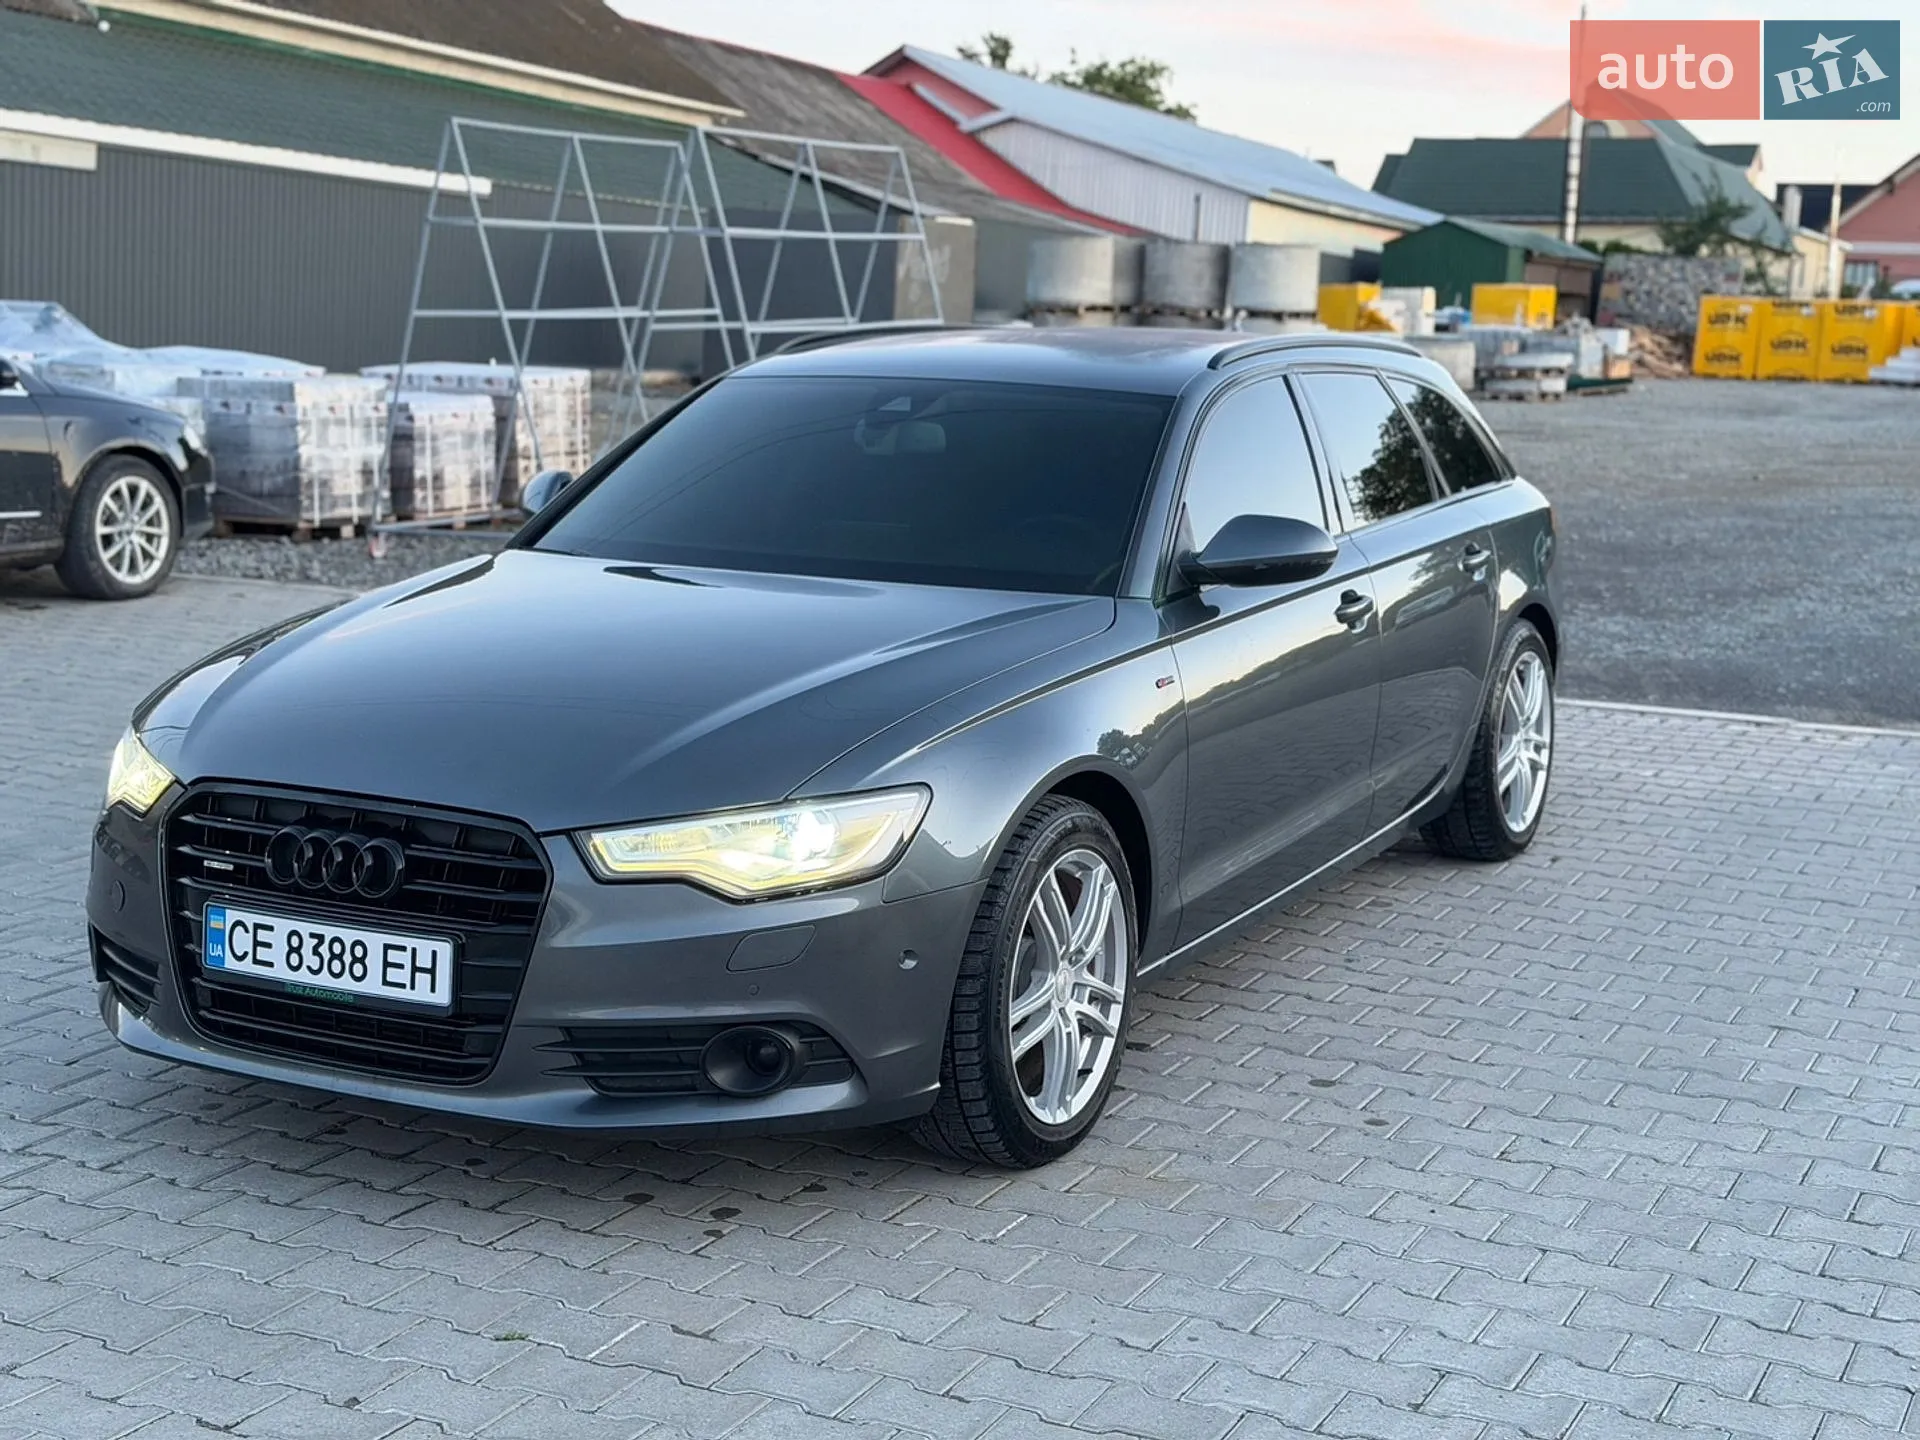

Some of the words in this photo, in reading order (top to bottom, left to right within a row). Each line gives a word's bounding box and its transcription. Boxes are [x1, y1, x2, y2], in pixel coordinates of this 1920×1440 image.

[209, 942, 224, 958] UA
[228, 919, 275, 968] CE
[285, 929, 368, 983] 8388
[381, 942, 437, 994] EH
